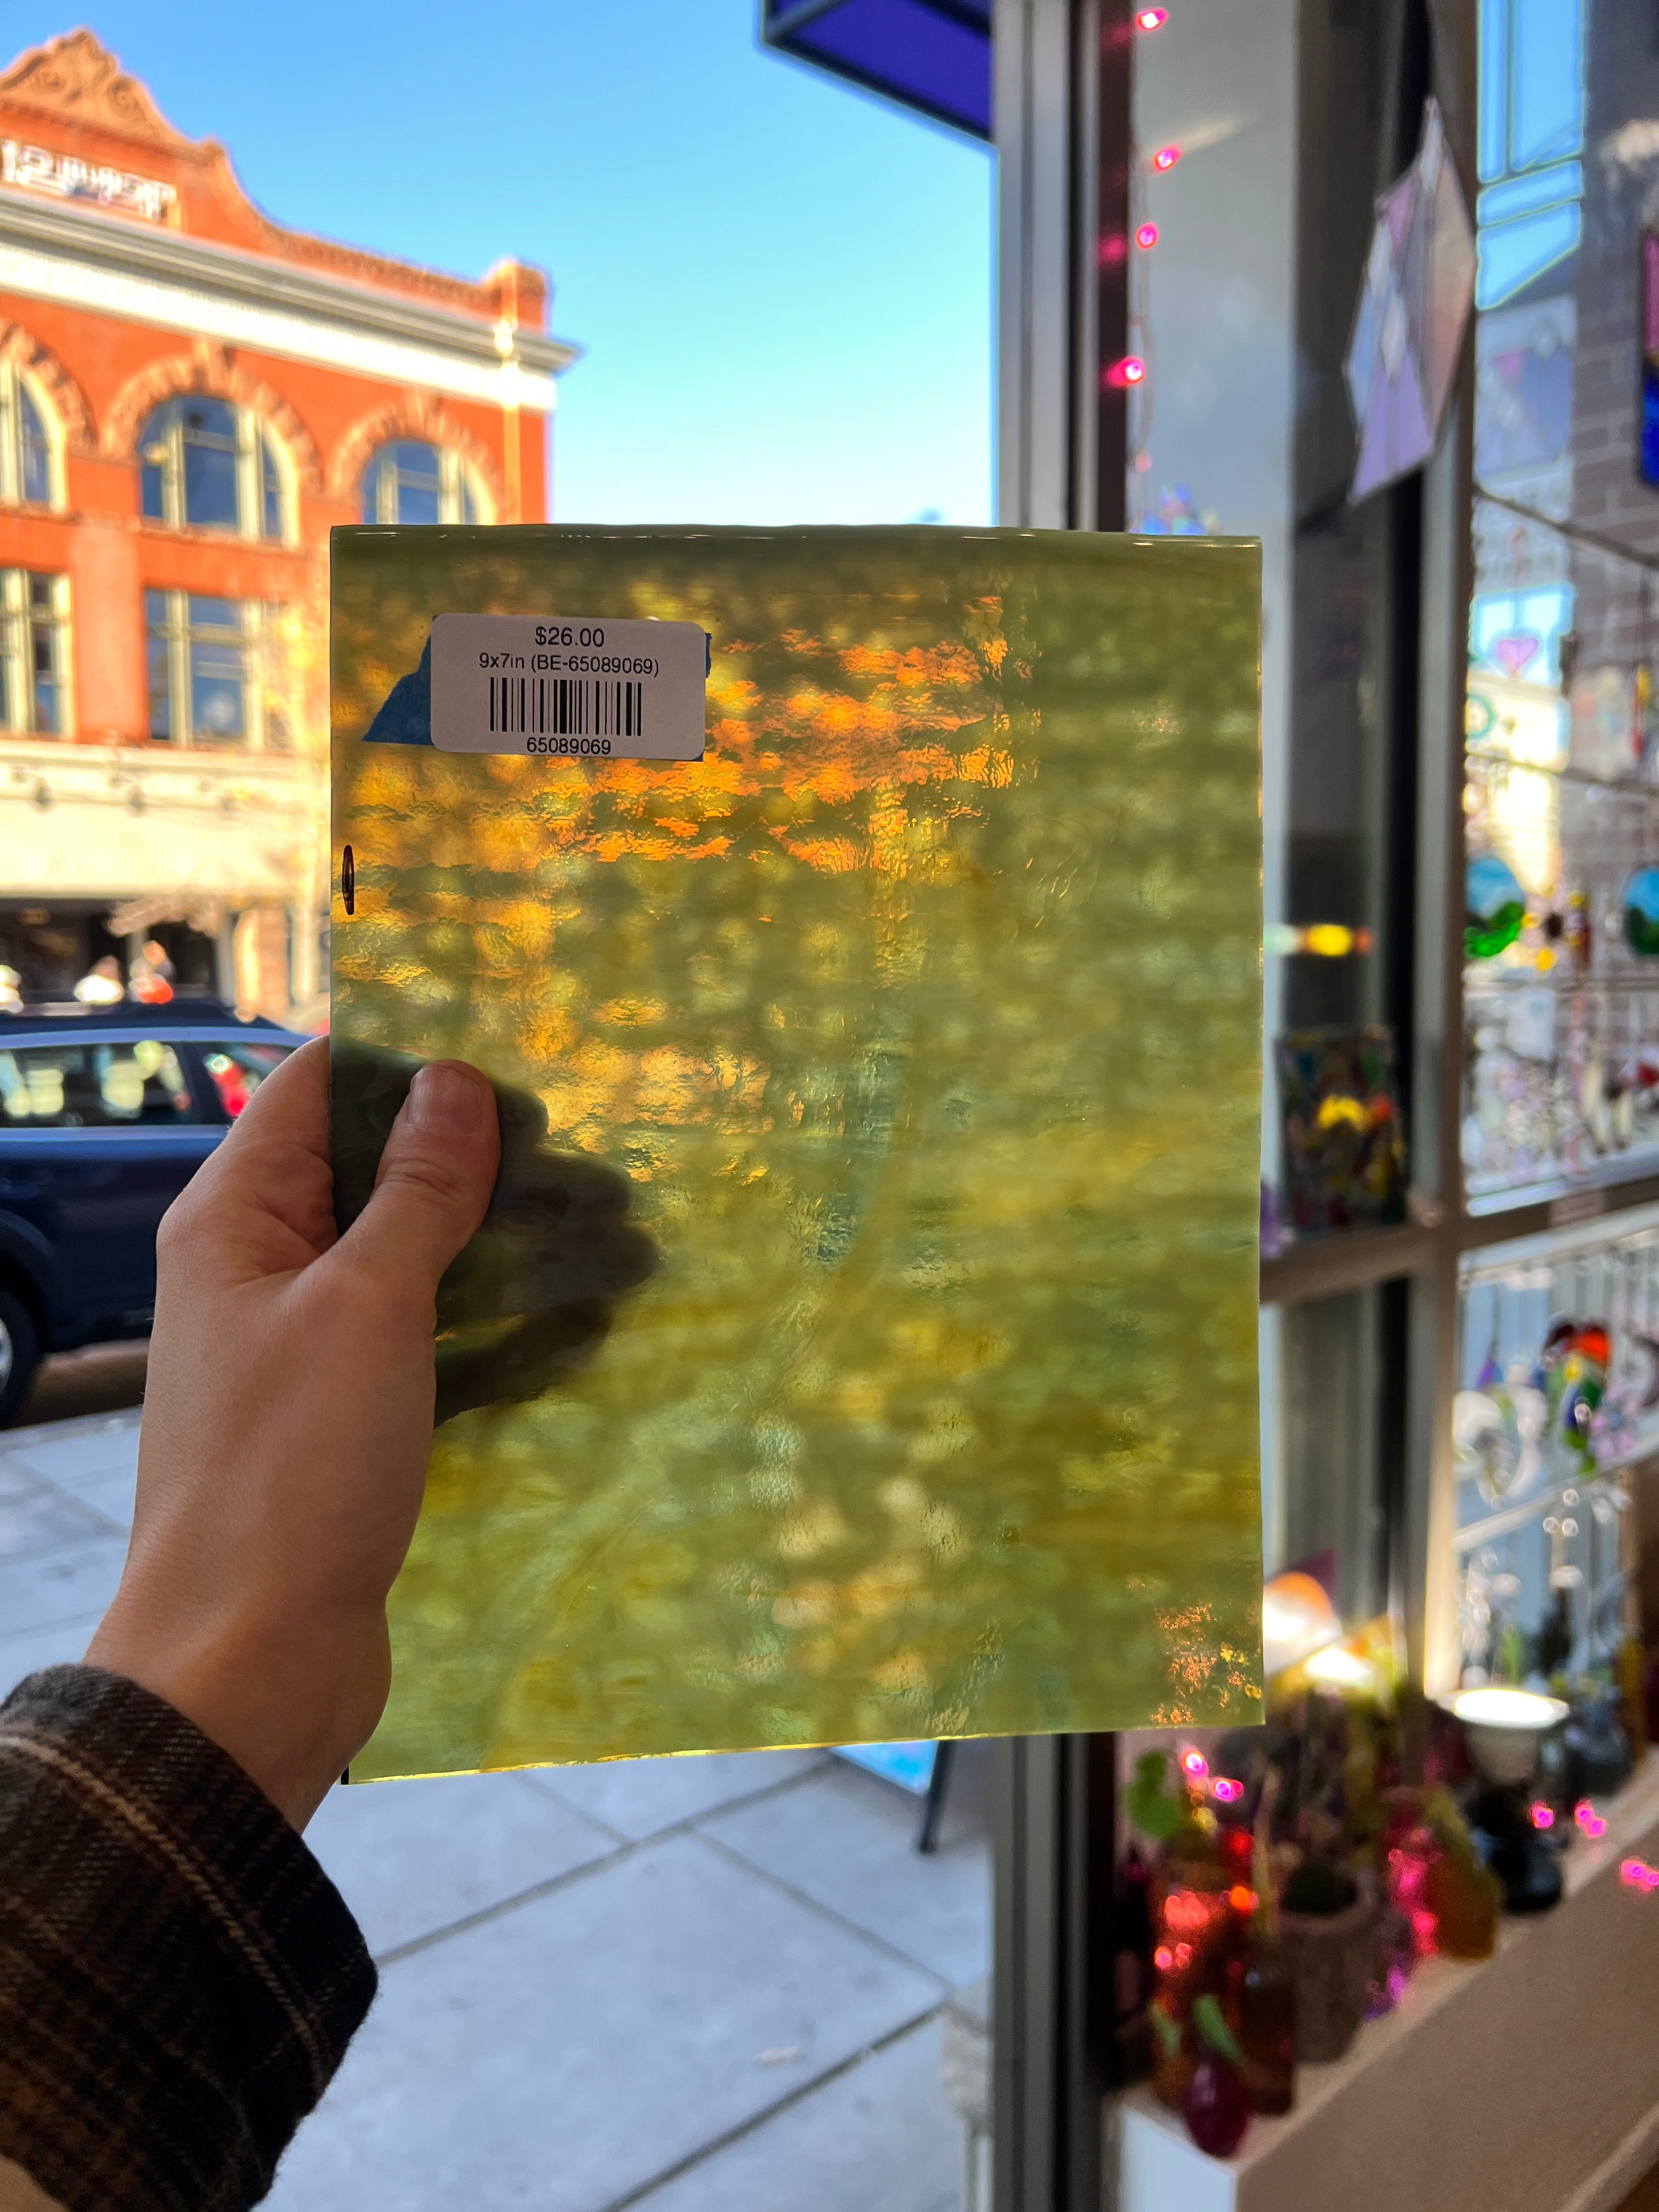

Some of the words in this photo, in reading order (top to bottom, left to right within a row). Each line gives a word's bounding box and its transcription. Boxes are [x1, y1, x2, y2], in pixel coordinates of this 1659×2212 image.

[534, 625, 605, 648] $26.00
[479, 652, 525, 669] 9x7in
[531, 654, 659, 678] (BE-65089069)
[526, 737, 611, 755] 65089069
